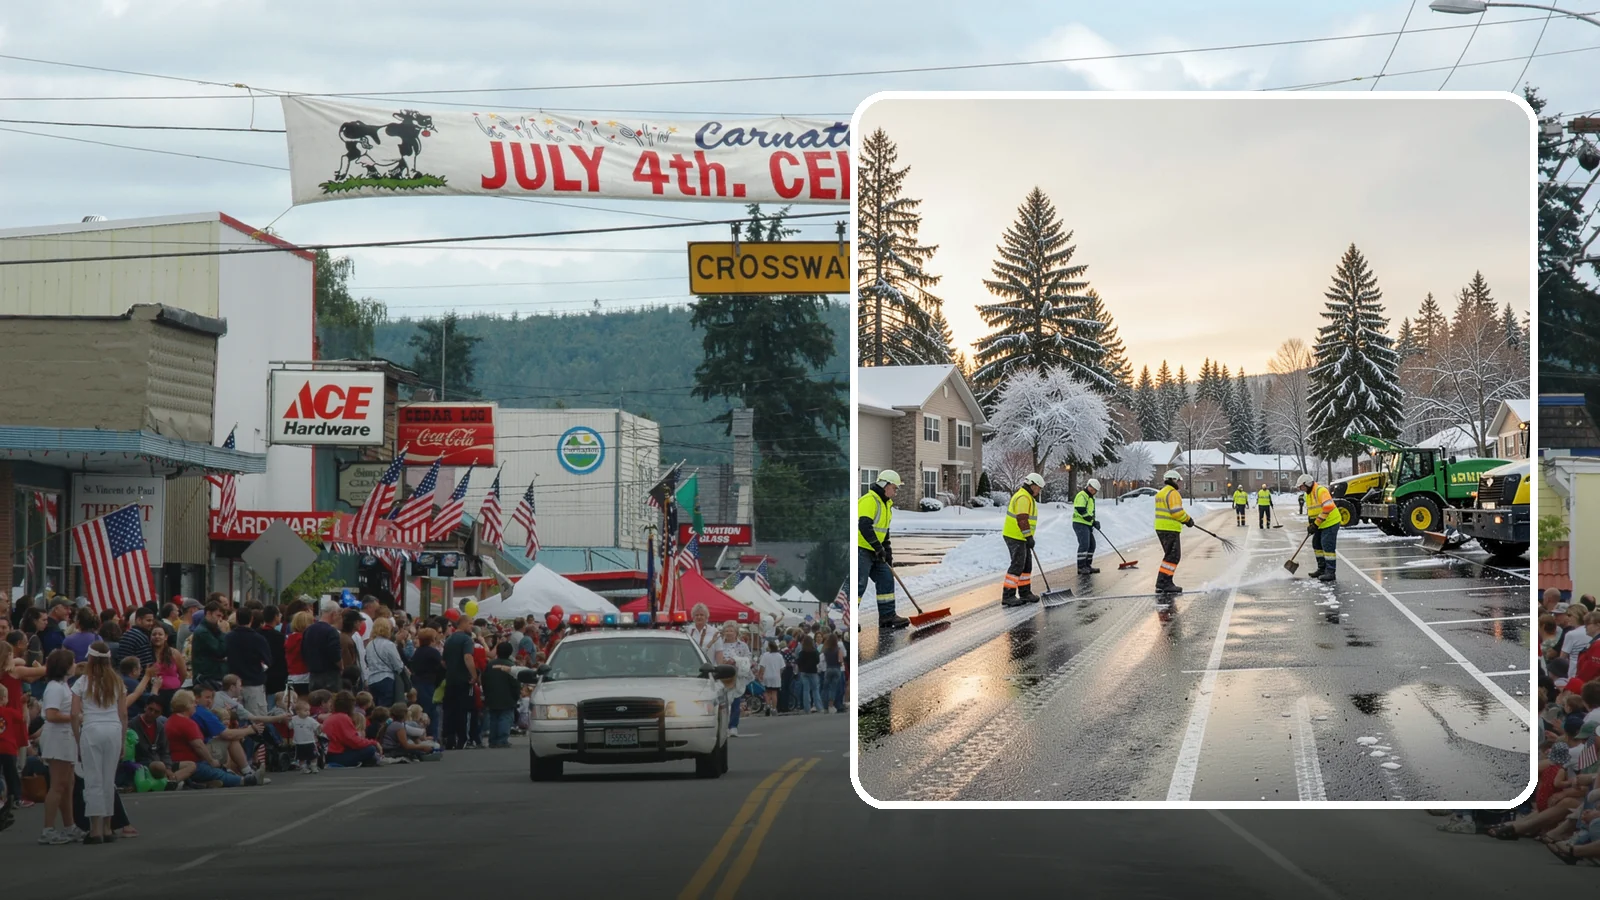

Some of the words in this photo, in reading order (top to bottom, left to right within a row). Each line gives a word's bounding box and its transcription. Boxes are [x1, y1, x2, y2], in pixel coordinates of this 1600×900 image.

[481, 141, 605, 193] JULY
[632, 150, 746, 198] 4th.
[697, 254, 850, 280] CROSSWA
[283, 380, 373, 420] ACE
[406, 409, 452, 421] CEDAR
[461, 409, 485, 421] LOG
[284, 421, 371, 436] Hardware
[96, 485, 124, 495] Vincent
[126, 486, 136, 494] de
[138, 486, 155, 495] Paul
